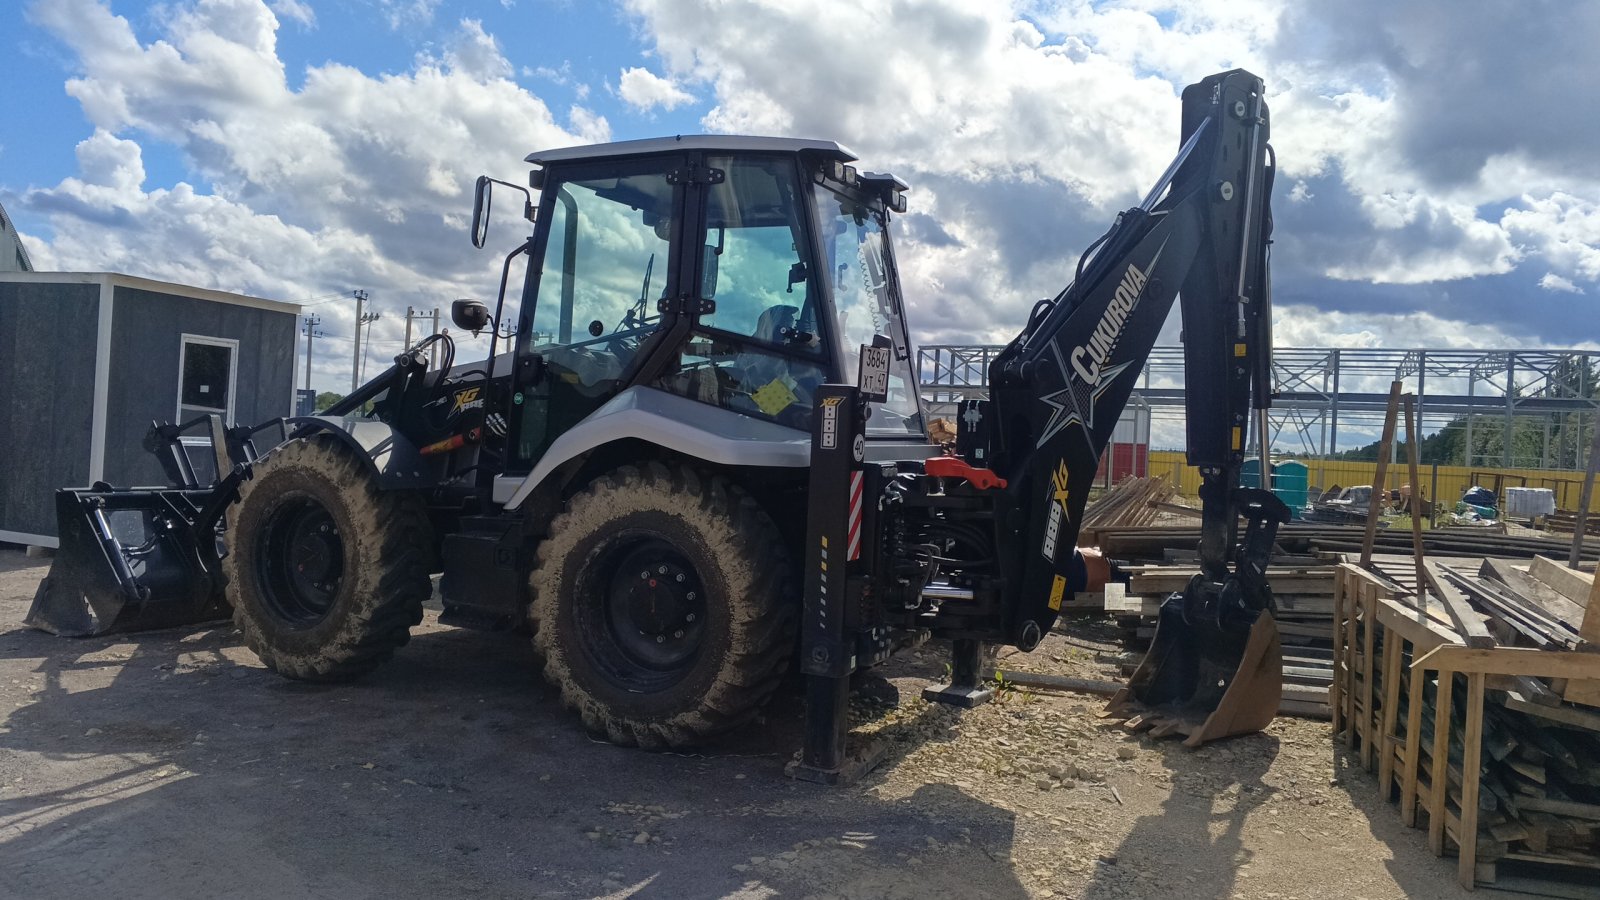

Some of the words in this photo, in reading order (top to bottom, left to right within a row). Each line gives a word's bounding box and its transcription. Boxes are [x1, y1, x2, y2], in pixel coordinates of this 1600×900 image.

[1070, 263, 1147, 385] CUKUROVA
[866, 348, 886, 369] 3684
[877, 373, 886, 387] 47
[854, 440, 864, 455] 40
